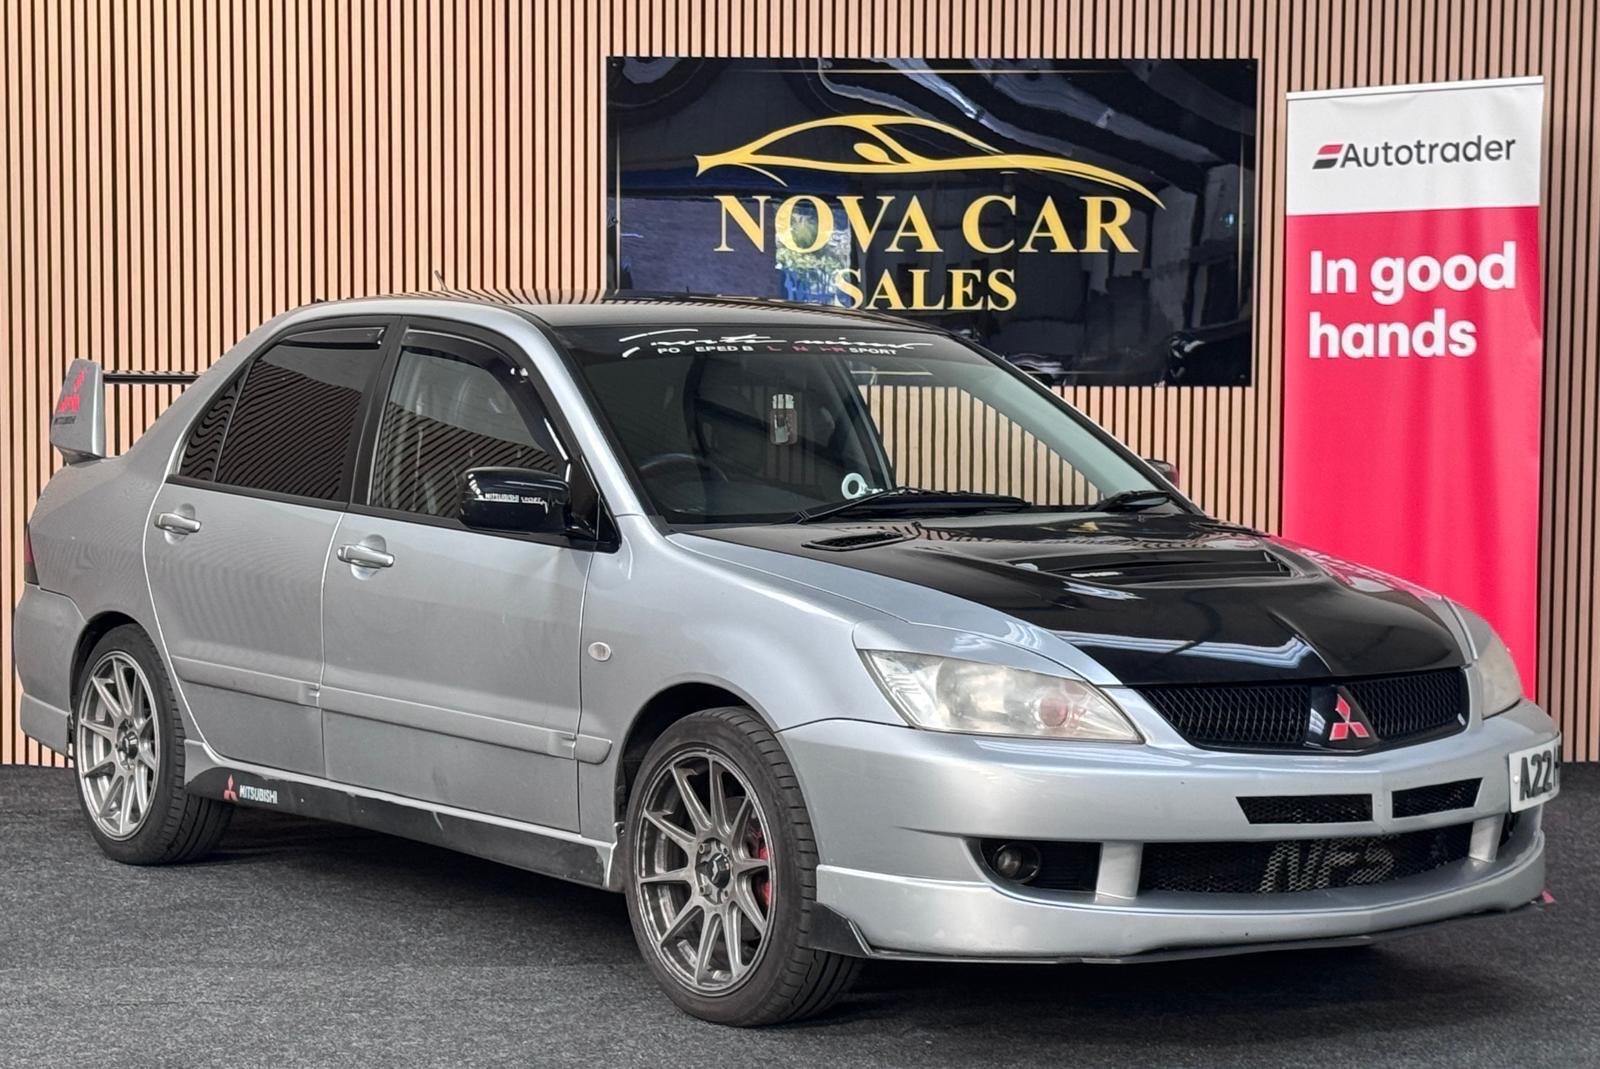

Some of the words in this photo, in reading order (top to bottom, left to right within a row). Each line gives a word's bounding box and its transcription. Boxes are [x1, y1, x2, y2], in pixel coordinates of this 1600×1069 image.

[1340, 134, 1517, 169] Autotrader
[713, 194, 943, 254] NOVA
[962, 194, 1139, 254] CAR
[834, 268, 1017, 312] SALES
[1310, 250, 1358, 294] In
[1370, 240, 1517, 305] good
[849, 346, 898, 356] SPORT
[1308, 307, 1478, 359] hands
[240, 785, 278, 804] MITSUBISHI
